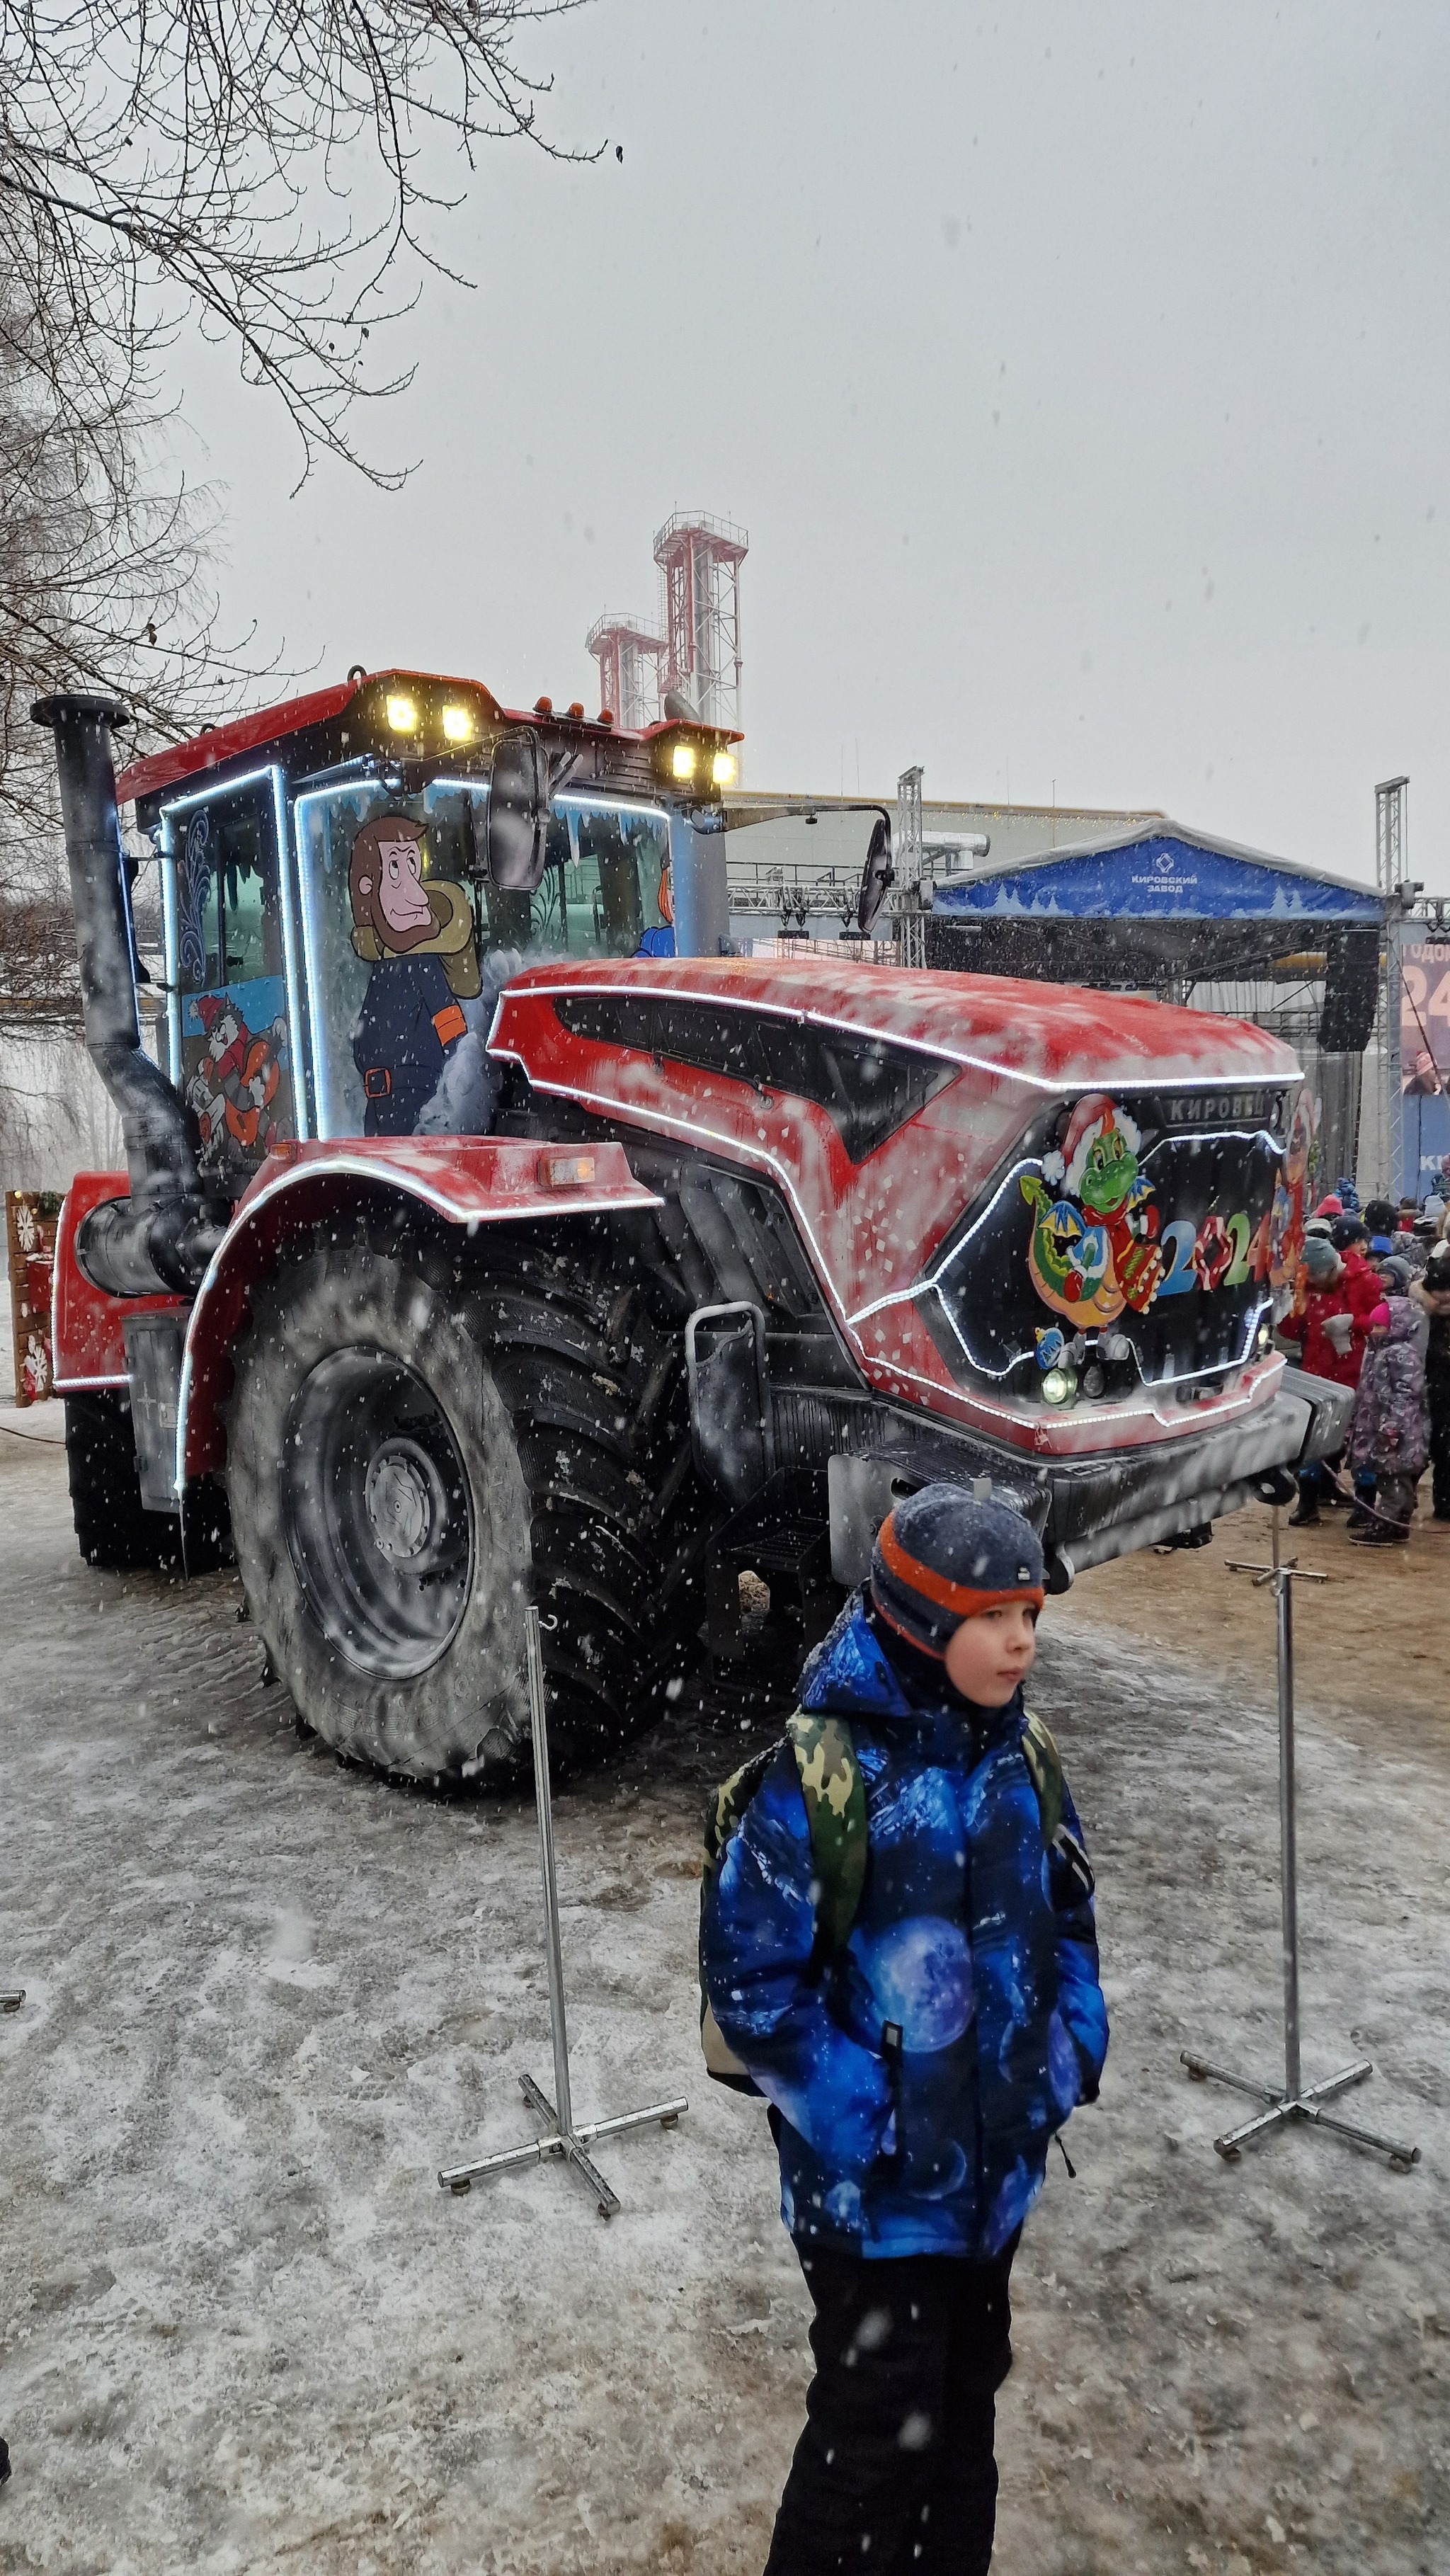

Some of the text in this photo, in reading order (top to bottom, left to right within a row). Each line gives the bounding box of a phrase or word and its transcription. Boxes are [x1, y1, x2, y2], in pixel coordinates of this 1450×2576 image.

[1131, 874, 1197, 884] КИРОВСКИЙ
[1170, 1093, 1265, 1121] КИРОВЕЦ
[1157, 1212, 1272, 1296] 2024
